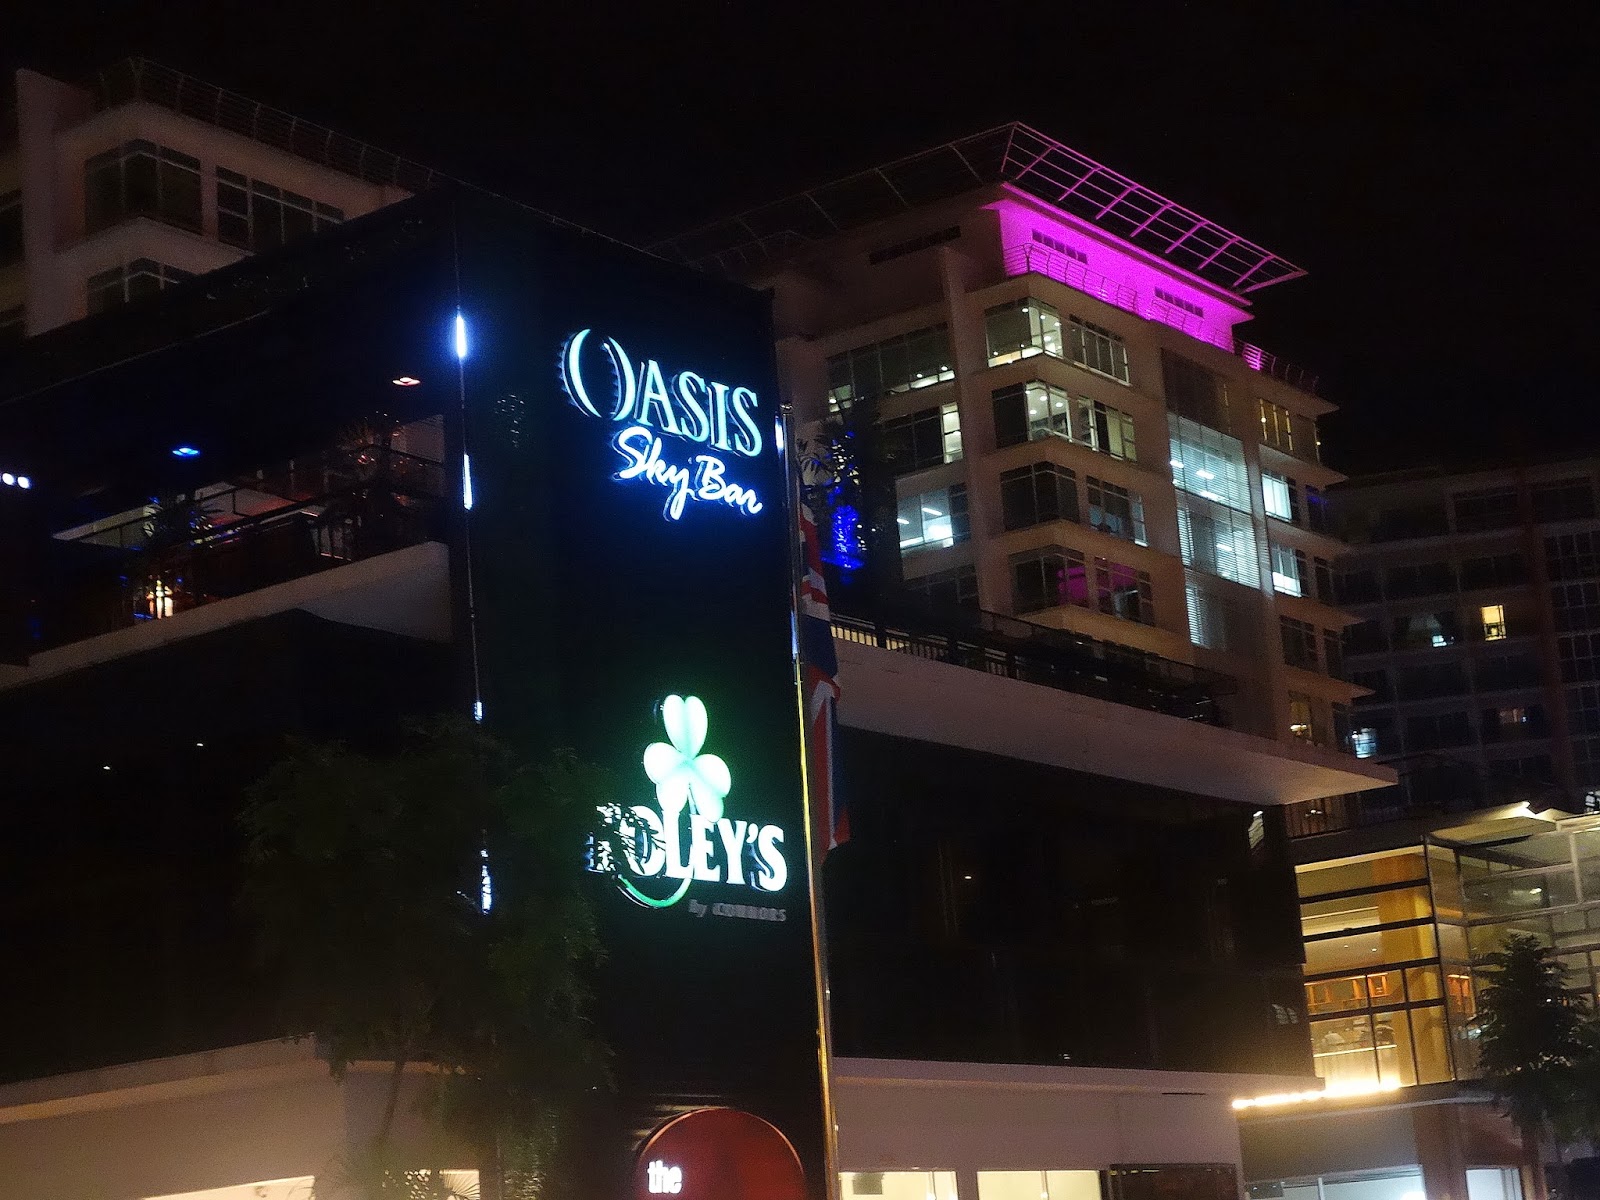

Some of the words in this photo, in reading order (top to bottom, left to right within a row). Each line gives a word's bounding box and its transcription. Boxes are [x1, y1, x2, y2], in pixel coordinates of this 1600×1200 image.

[563, 328, 763, 458] OASIS
[614, 425, 694, 521] Sky
[696, 454, 764, 515] Bar
[646, 1159, 683, 1194] the
